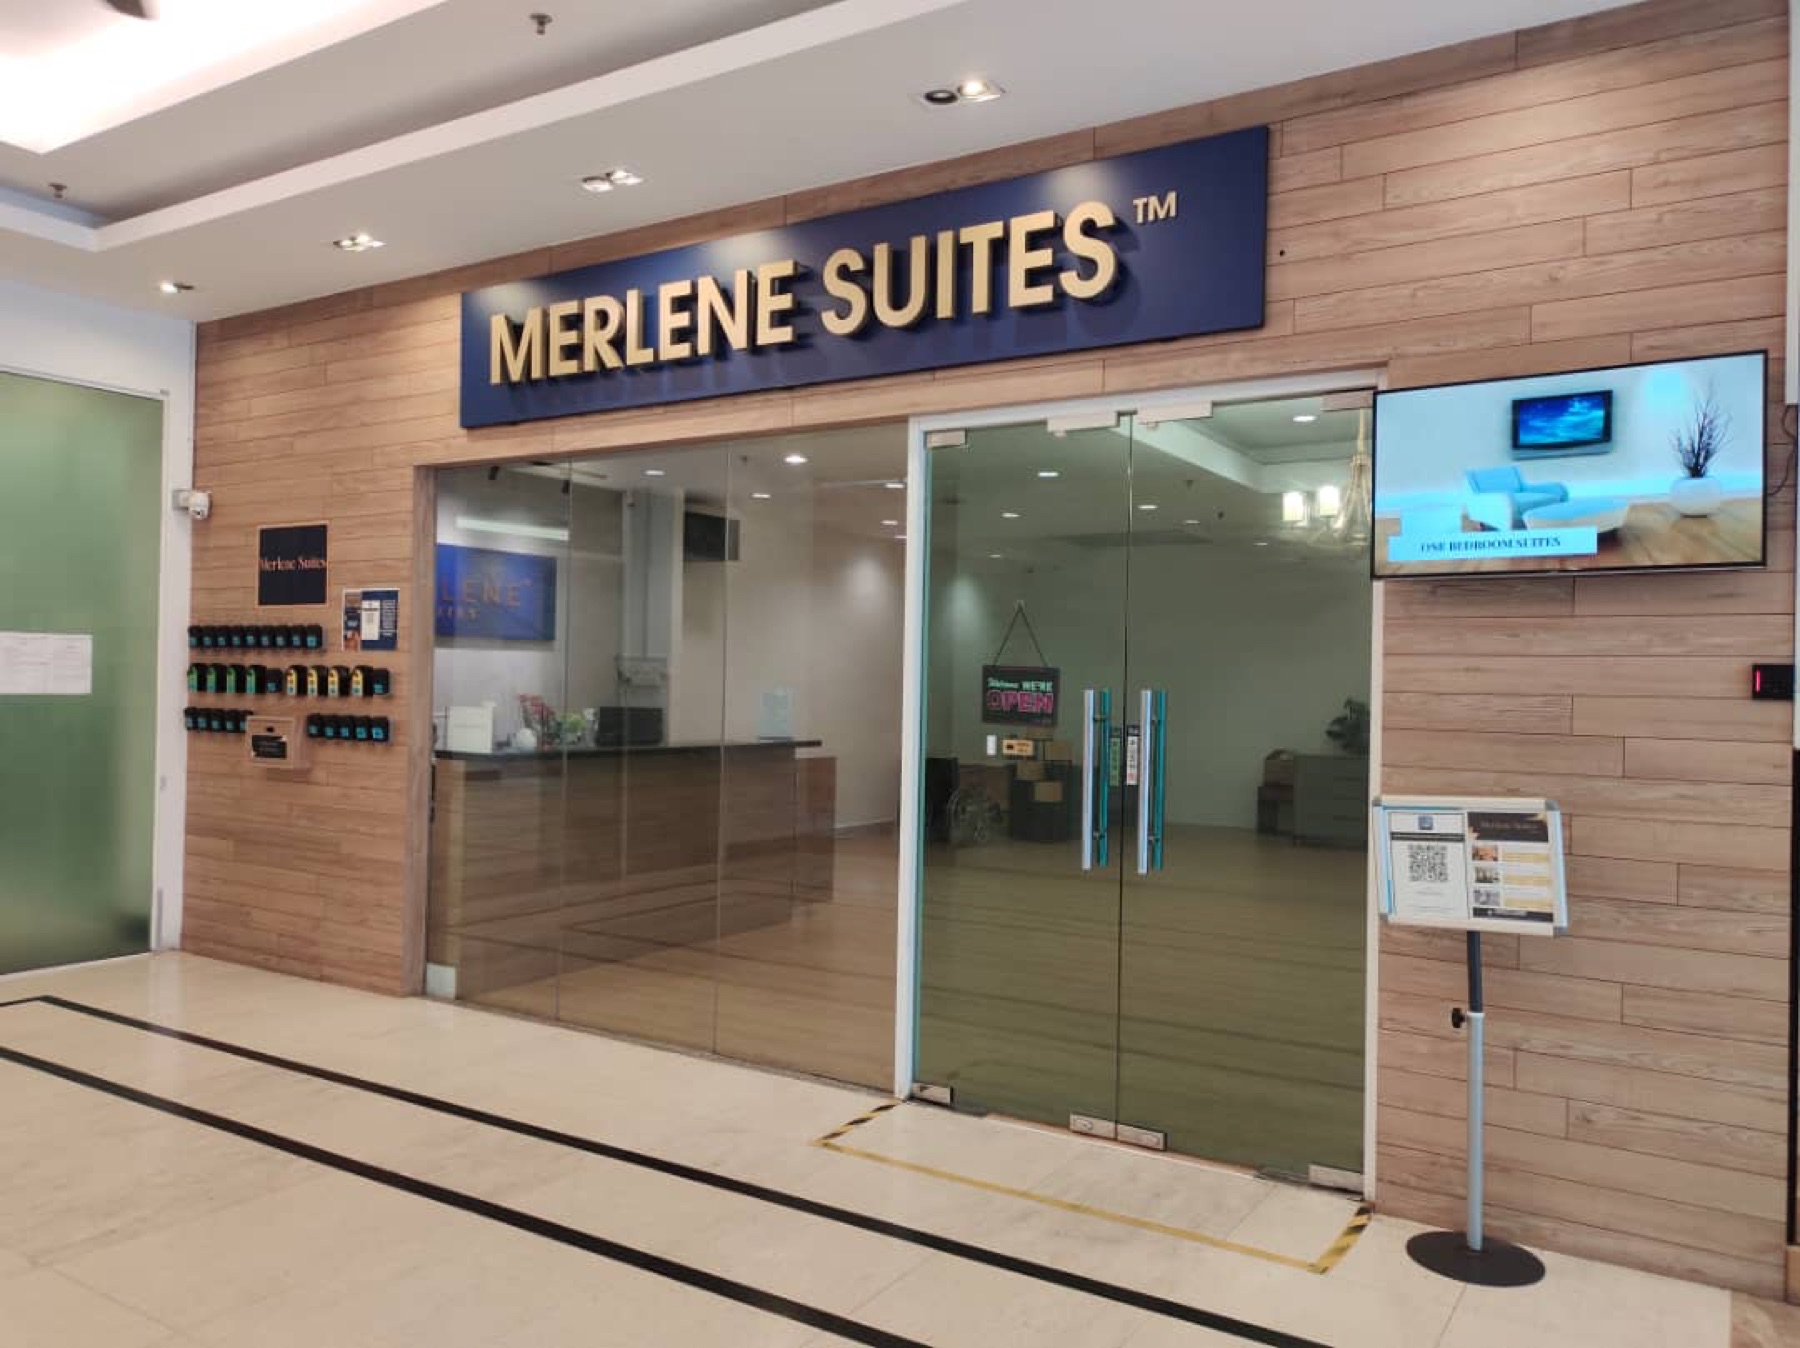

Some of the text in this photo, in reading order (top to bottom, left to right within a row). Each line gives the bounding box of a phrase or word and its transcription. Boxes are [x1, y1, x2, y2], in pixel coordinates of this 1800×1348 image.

[489, 191, 1178, 386] MERLENE SUITES TM
[988, 690, 1054, 713] OPEN
